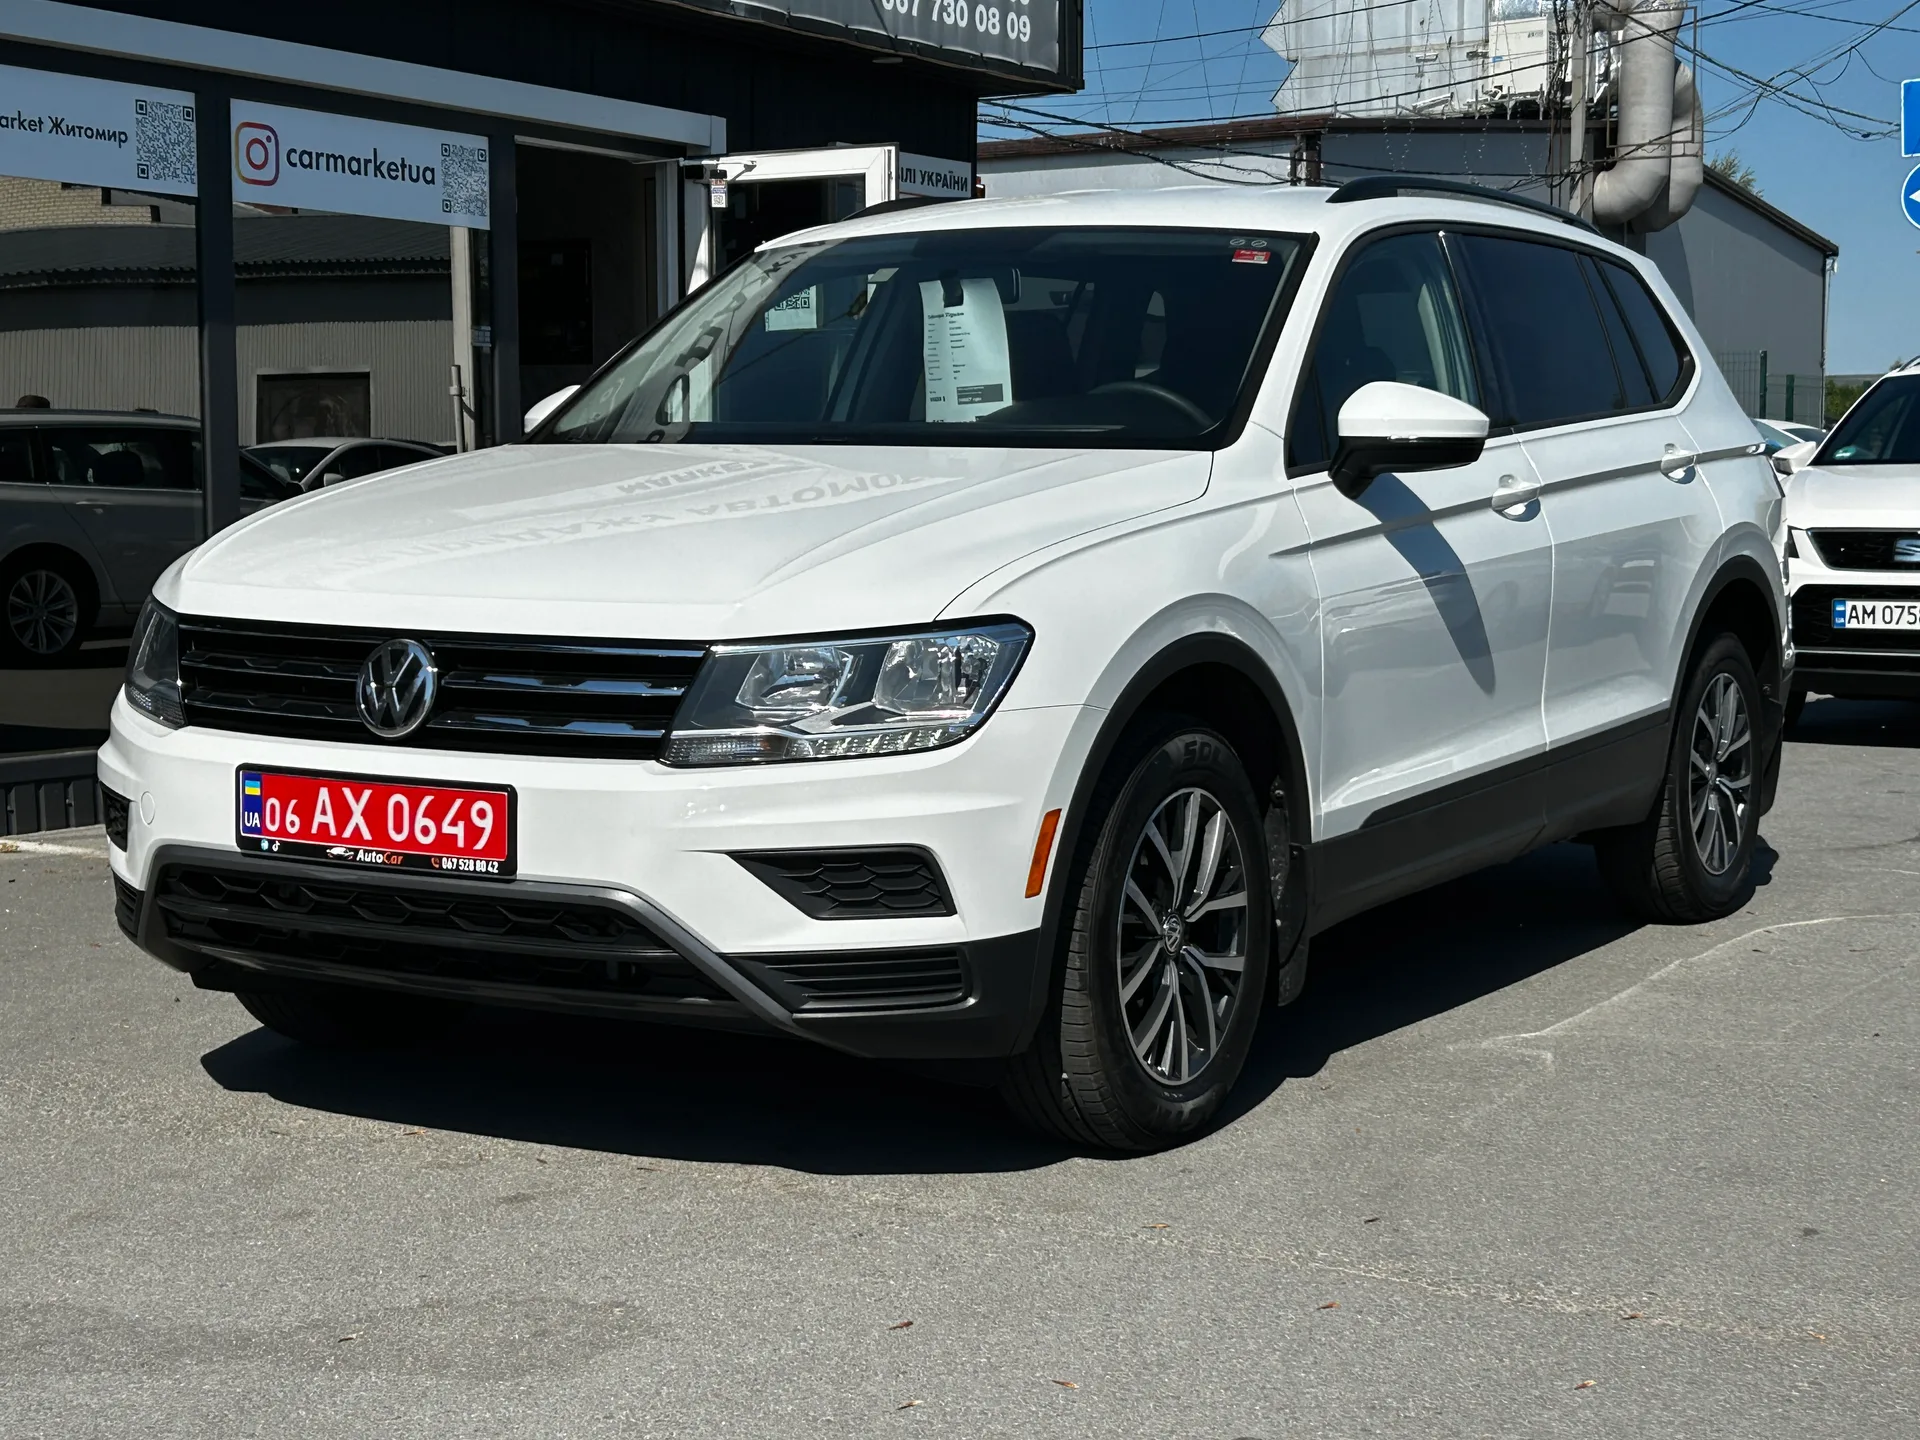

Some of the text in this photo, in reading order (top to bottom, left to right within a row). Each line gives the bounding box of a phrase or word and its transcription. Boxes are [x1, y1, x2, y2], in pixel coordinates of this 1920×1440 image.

[932, 0, 969, 28] 730
[975, 4, 1001, 35] 08
[1006, 12, 1031, 43] 09
[48, 115, 128, 148] Житомир
[286, 147, 436, 185] carmarketua
[898, 167, 968, 192] ІЛІ УКРАЇНИ
[1847, 604, 1920, 625] AM 075
[244, 811, 261, 828] UA
[265, 786, 494, 851] 06 AX 0649
[356, 848, 404, 865] AutoCar
[441, 857, 457, 869] 067
[487, 861, 499, 873] 42
